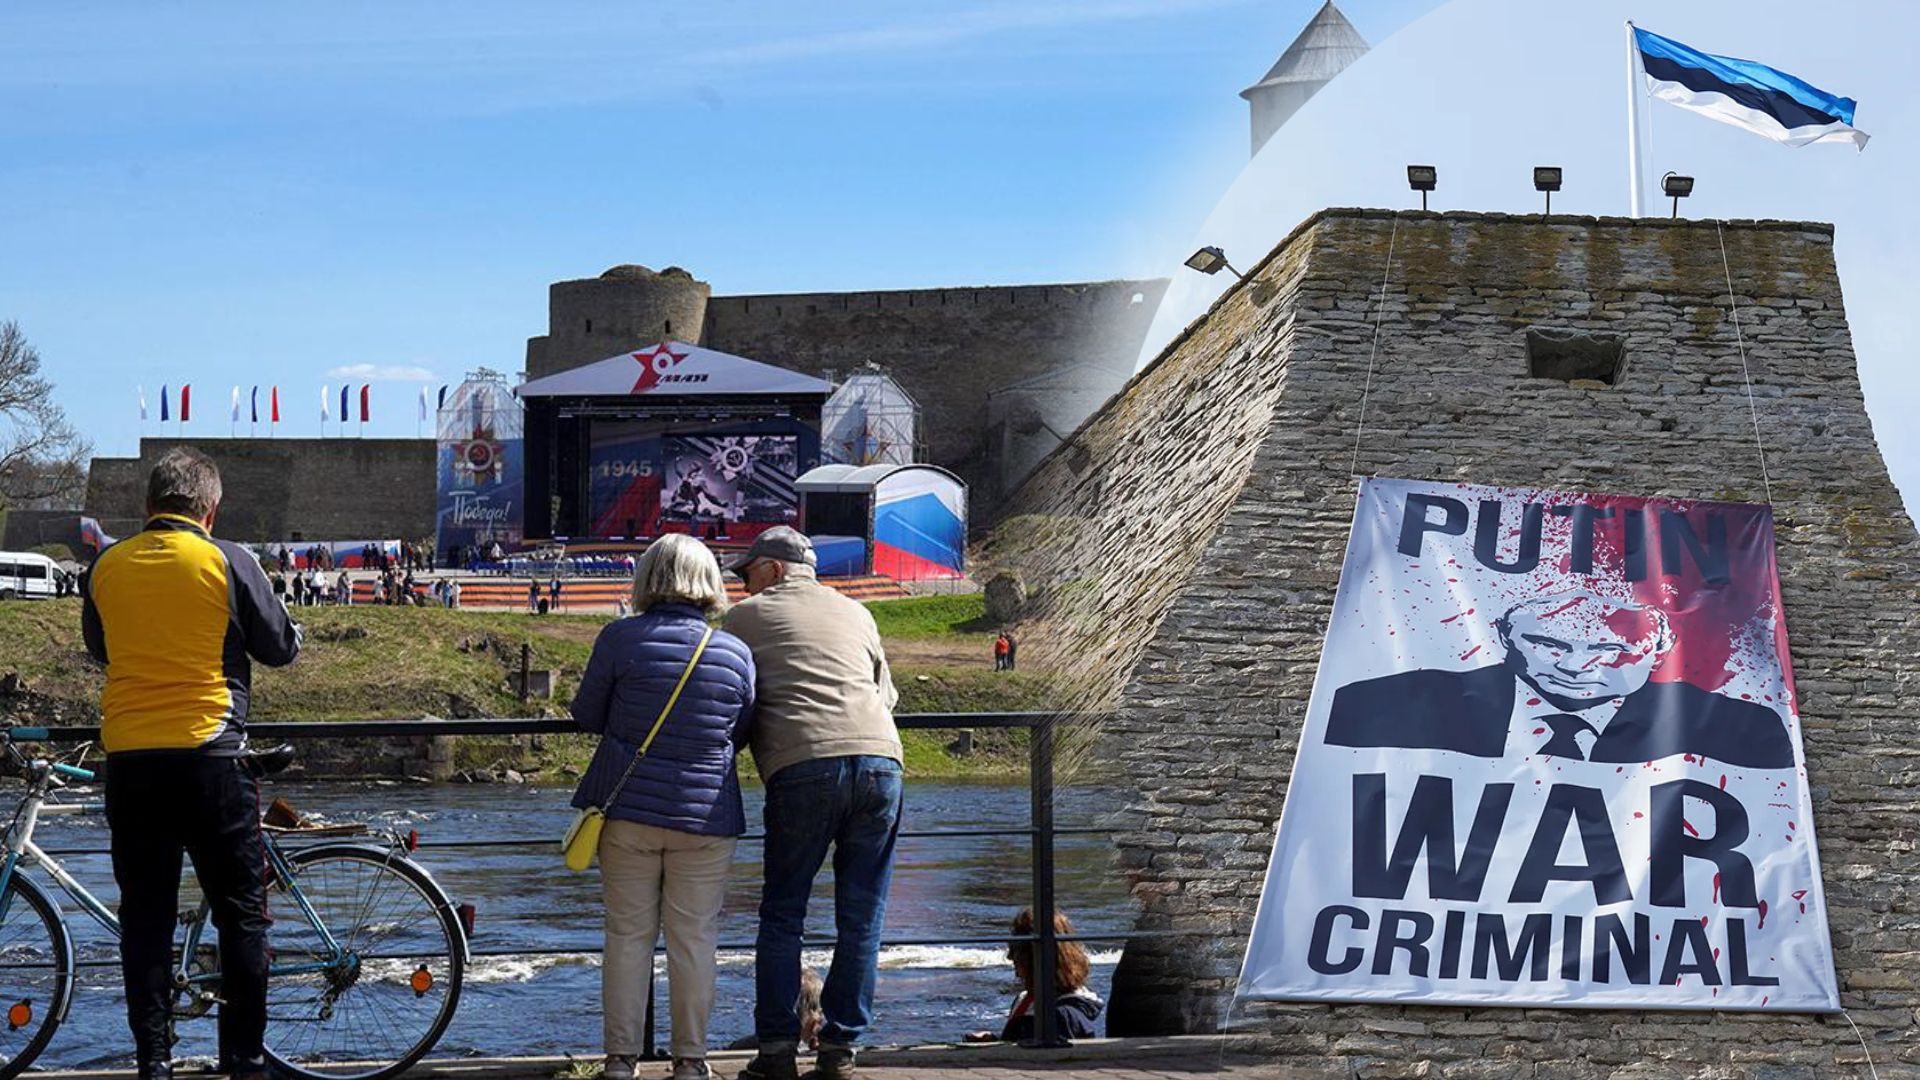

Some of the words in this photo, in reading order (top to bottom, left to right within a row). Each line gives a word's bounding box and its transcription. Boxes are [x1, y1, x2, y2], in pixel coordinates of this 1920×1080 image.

[598, 461, 652, 477] 1945
[1397, 492, 1731, 585] PUTIN
[1352, 773, 1759, 908] WAR
[1306, 905, 1780, 986] CRIMINAL
